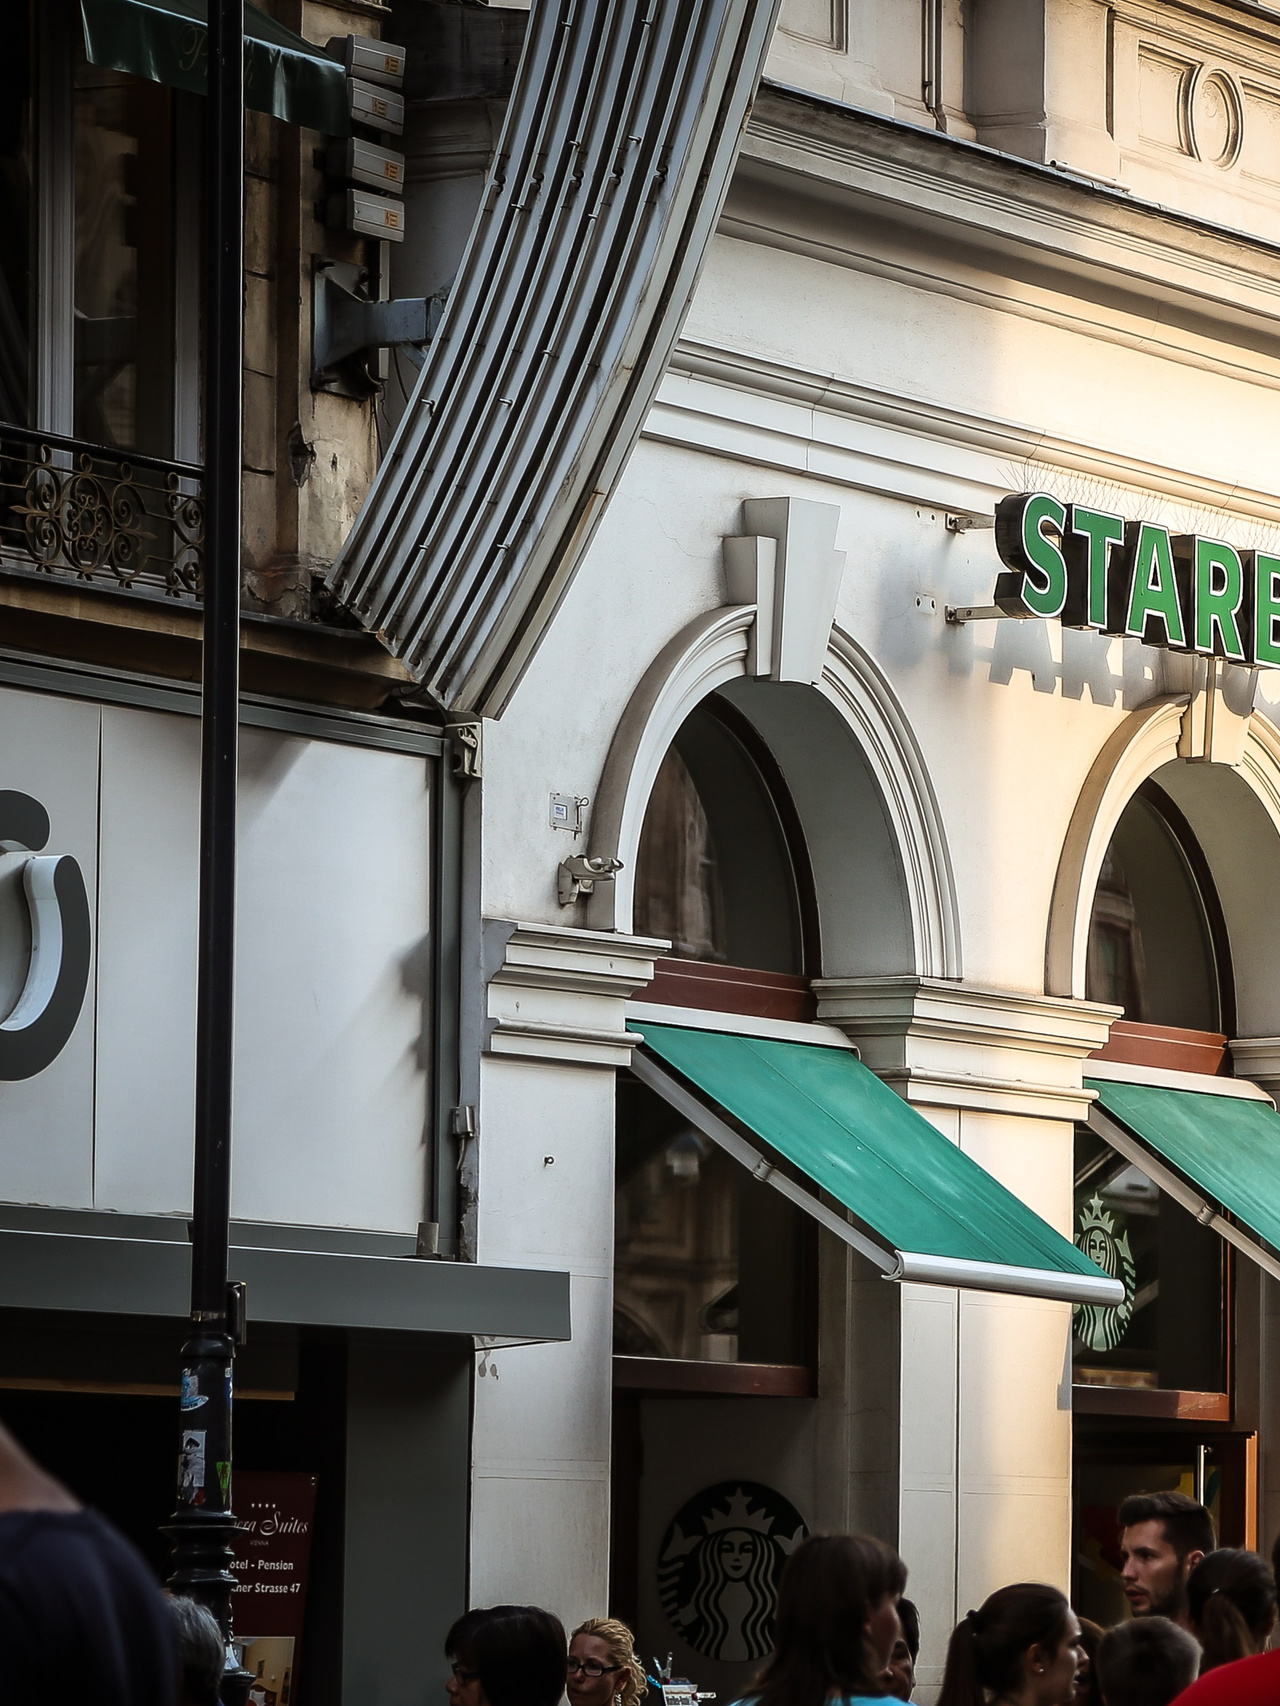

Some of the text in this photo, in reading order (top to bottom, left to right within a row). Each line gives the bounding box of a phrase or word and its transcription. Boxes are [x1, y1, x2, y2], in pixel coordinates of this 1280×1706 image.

[260, 1511, 309, 1536] Suites
[229, 1559, 249, 1569] otel
[258, 1559, 294, 1570] Pension
[254, 1582, 288, 1593] Strasse
[289, 1583, 301, 1593] 47
